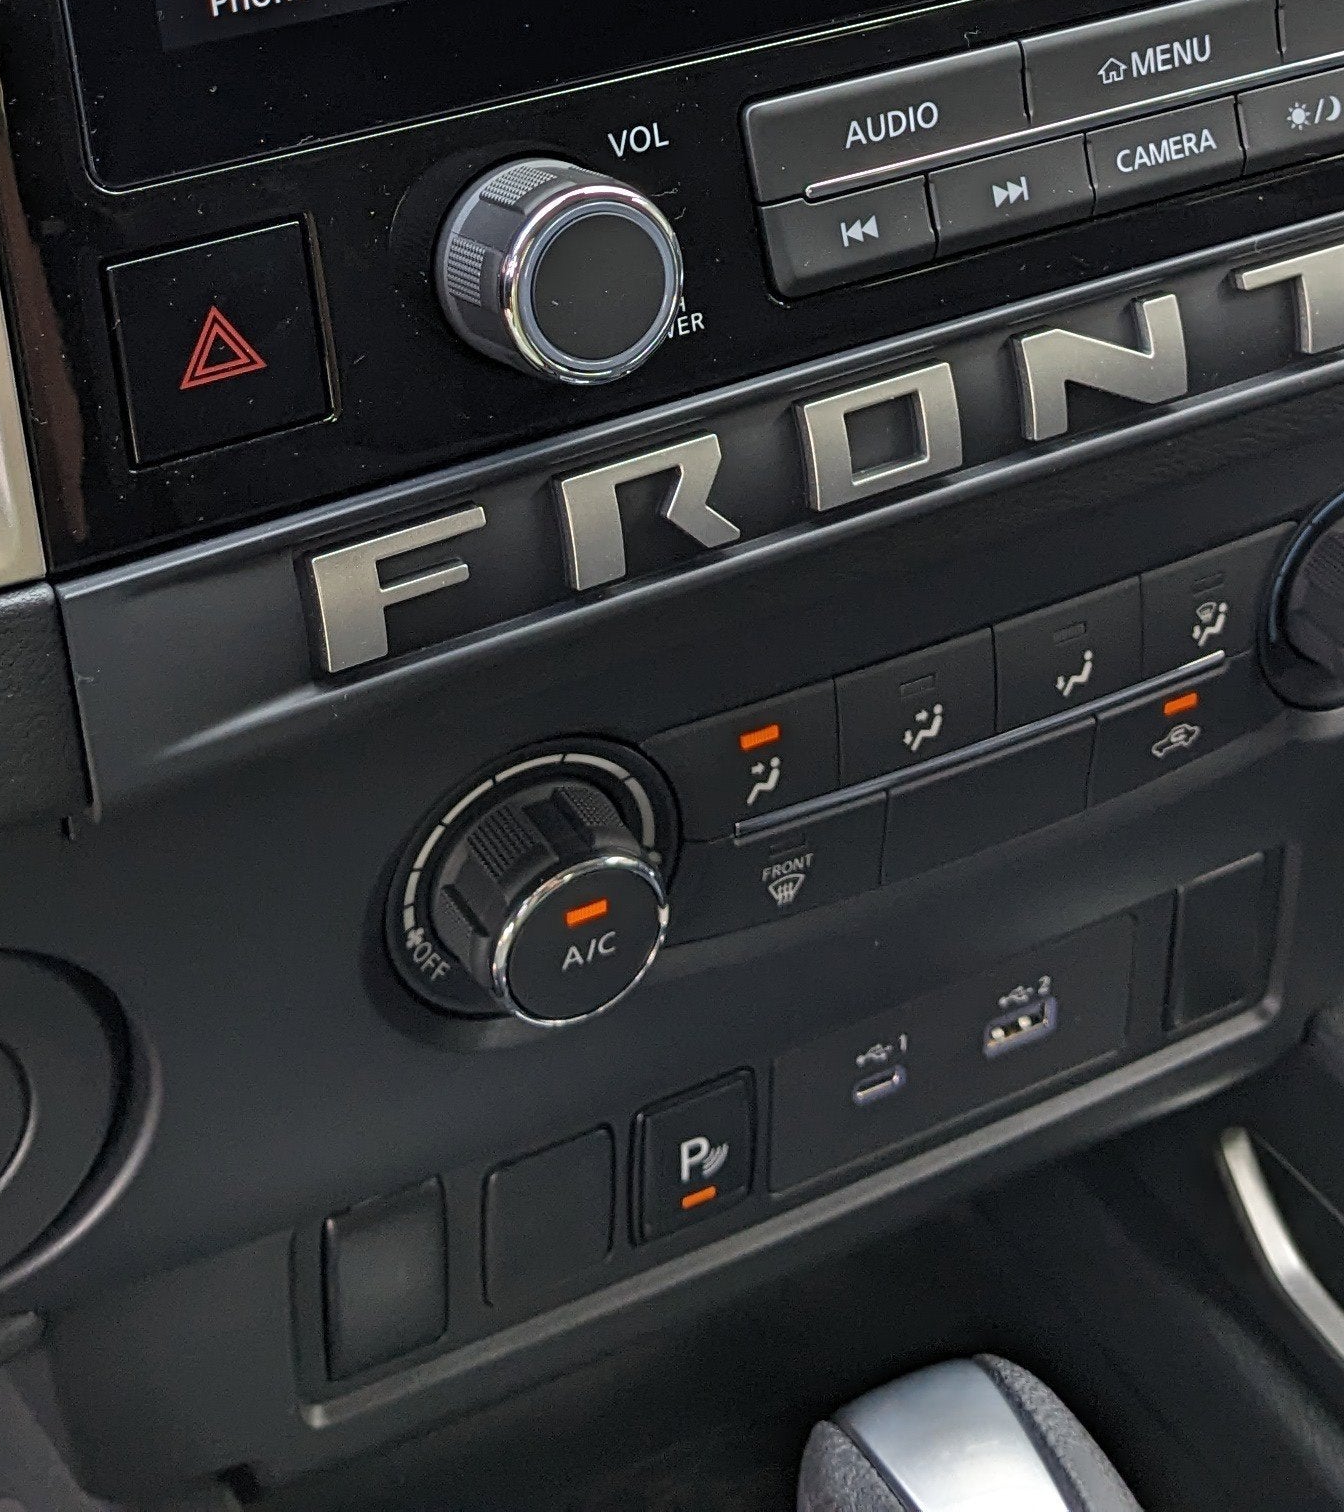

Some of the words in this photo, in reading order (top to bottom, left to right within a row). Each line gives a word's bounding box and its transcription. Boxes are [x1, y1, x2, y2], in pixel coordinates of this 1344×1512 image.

[1131, 35, 1212, 78] MENU
[608, 122, 670, 159] VOL
[845, 101, 939, 149] AUDIO
[1116, 128, 1217, 174] CAMERA
[761, 852, 814, 883] FRONT
[412, 938, 451, 982] OFF
[562, 930, 617, 971] A/C
